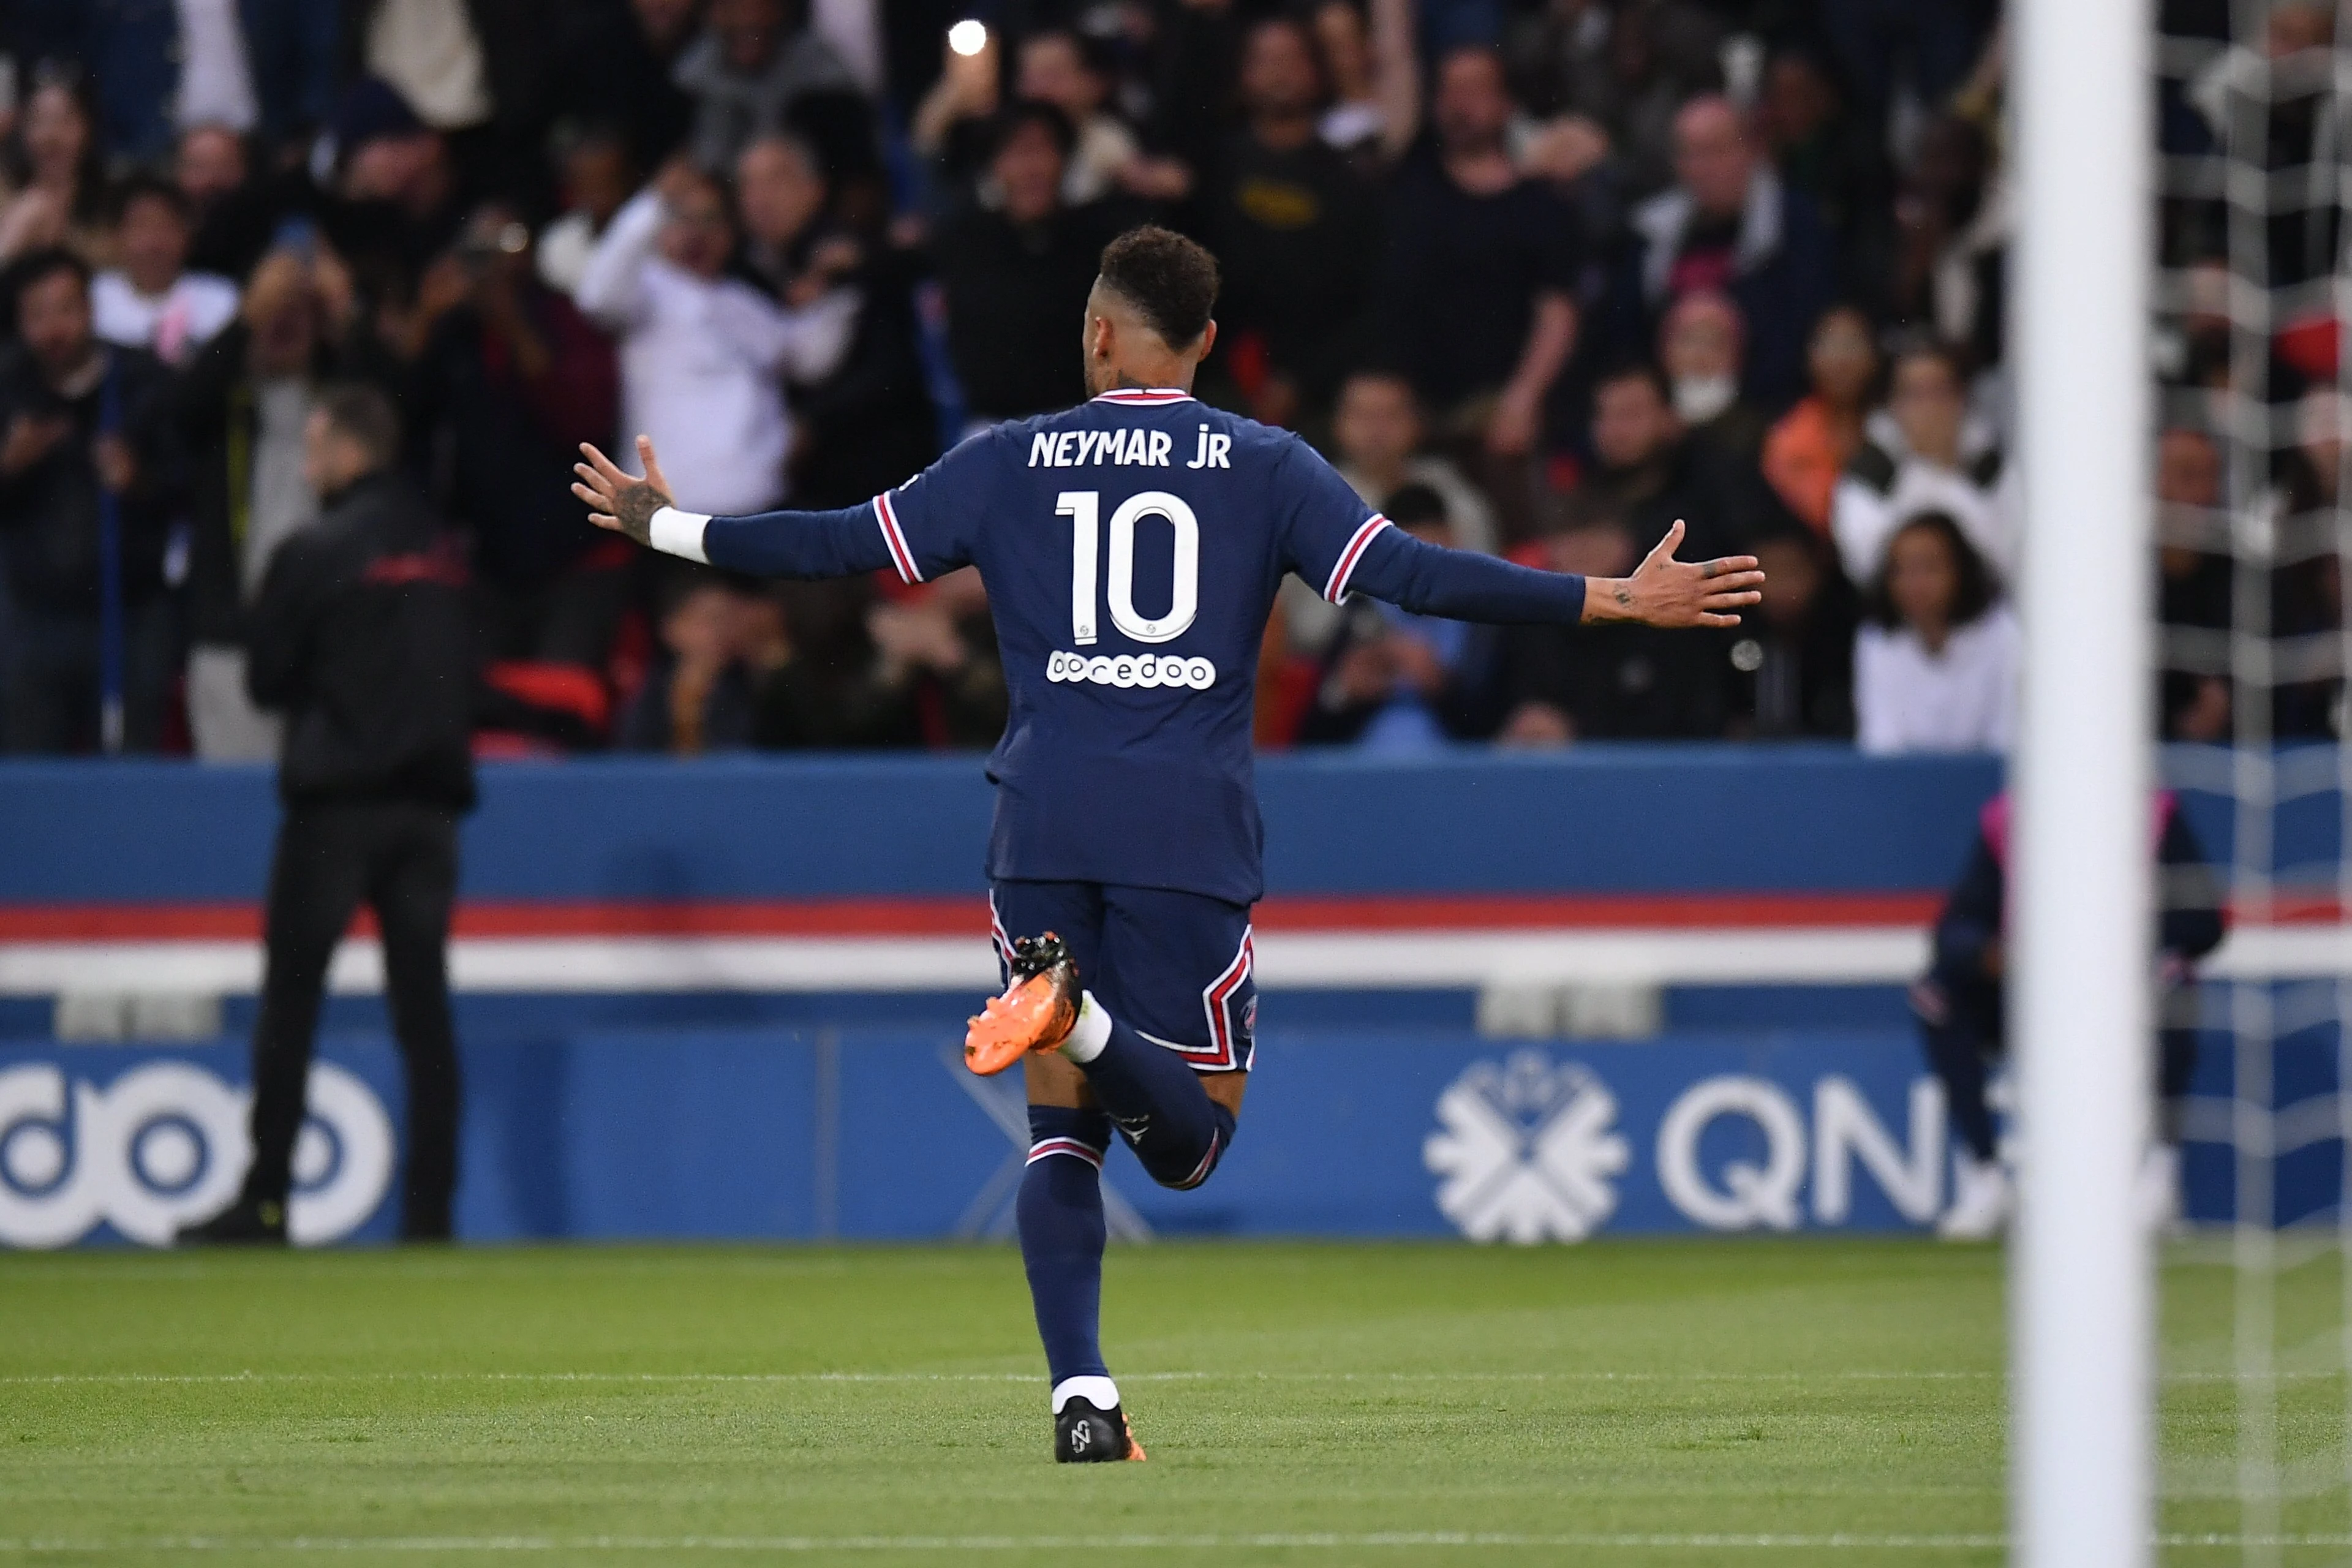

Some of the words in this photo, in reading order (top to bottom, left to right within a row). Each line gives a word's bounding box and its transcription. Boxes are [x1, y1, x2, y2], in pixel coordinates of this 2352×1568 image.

[1028, 428, 1172, 467] NEYMAR
[1055, 491, 1199, 646] 10
[1047, 650, 1215, 688] ooredoo
[1656, 1074, 2003, 1229] QN
